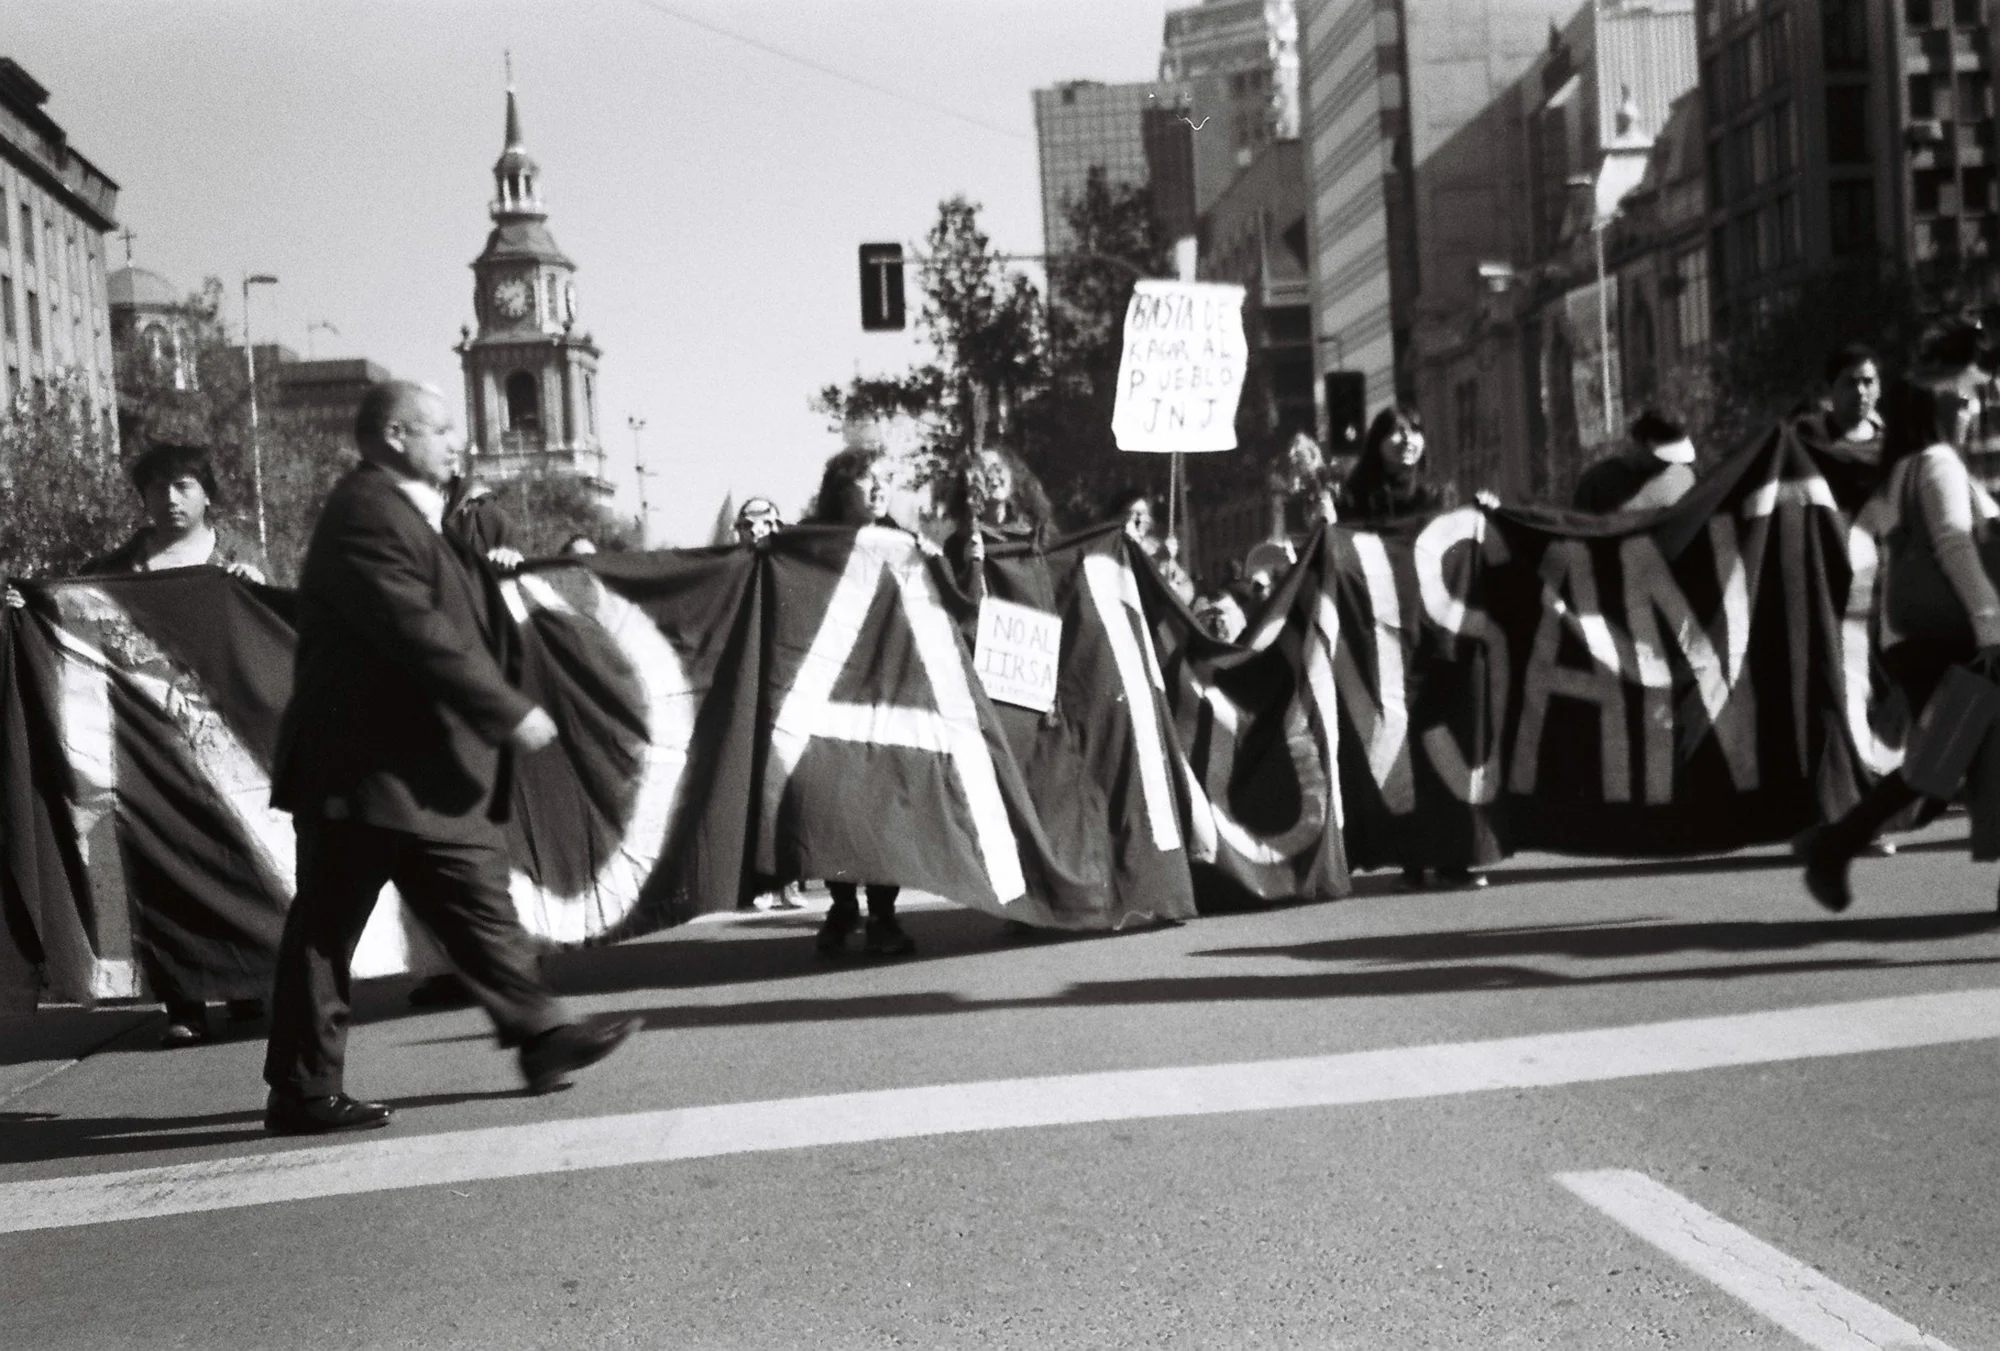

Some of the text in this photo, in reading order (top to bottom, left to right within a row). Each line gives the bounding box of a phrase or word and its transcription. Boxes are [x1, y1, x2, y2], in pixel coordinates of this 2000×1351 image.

[1131, 292, 1194, 332] BASTA
[1203, 338, 1232, 360] AL
[1129, 364, 1233, 400] PUEBLO
[993, 613, 1055, 656] NO AL
